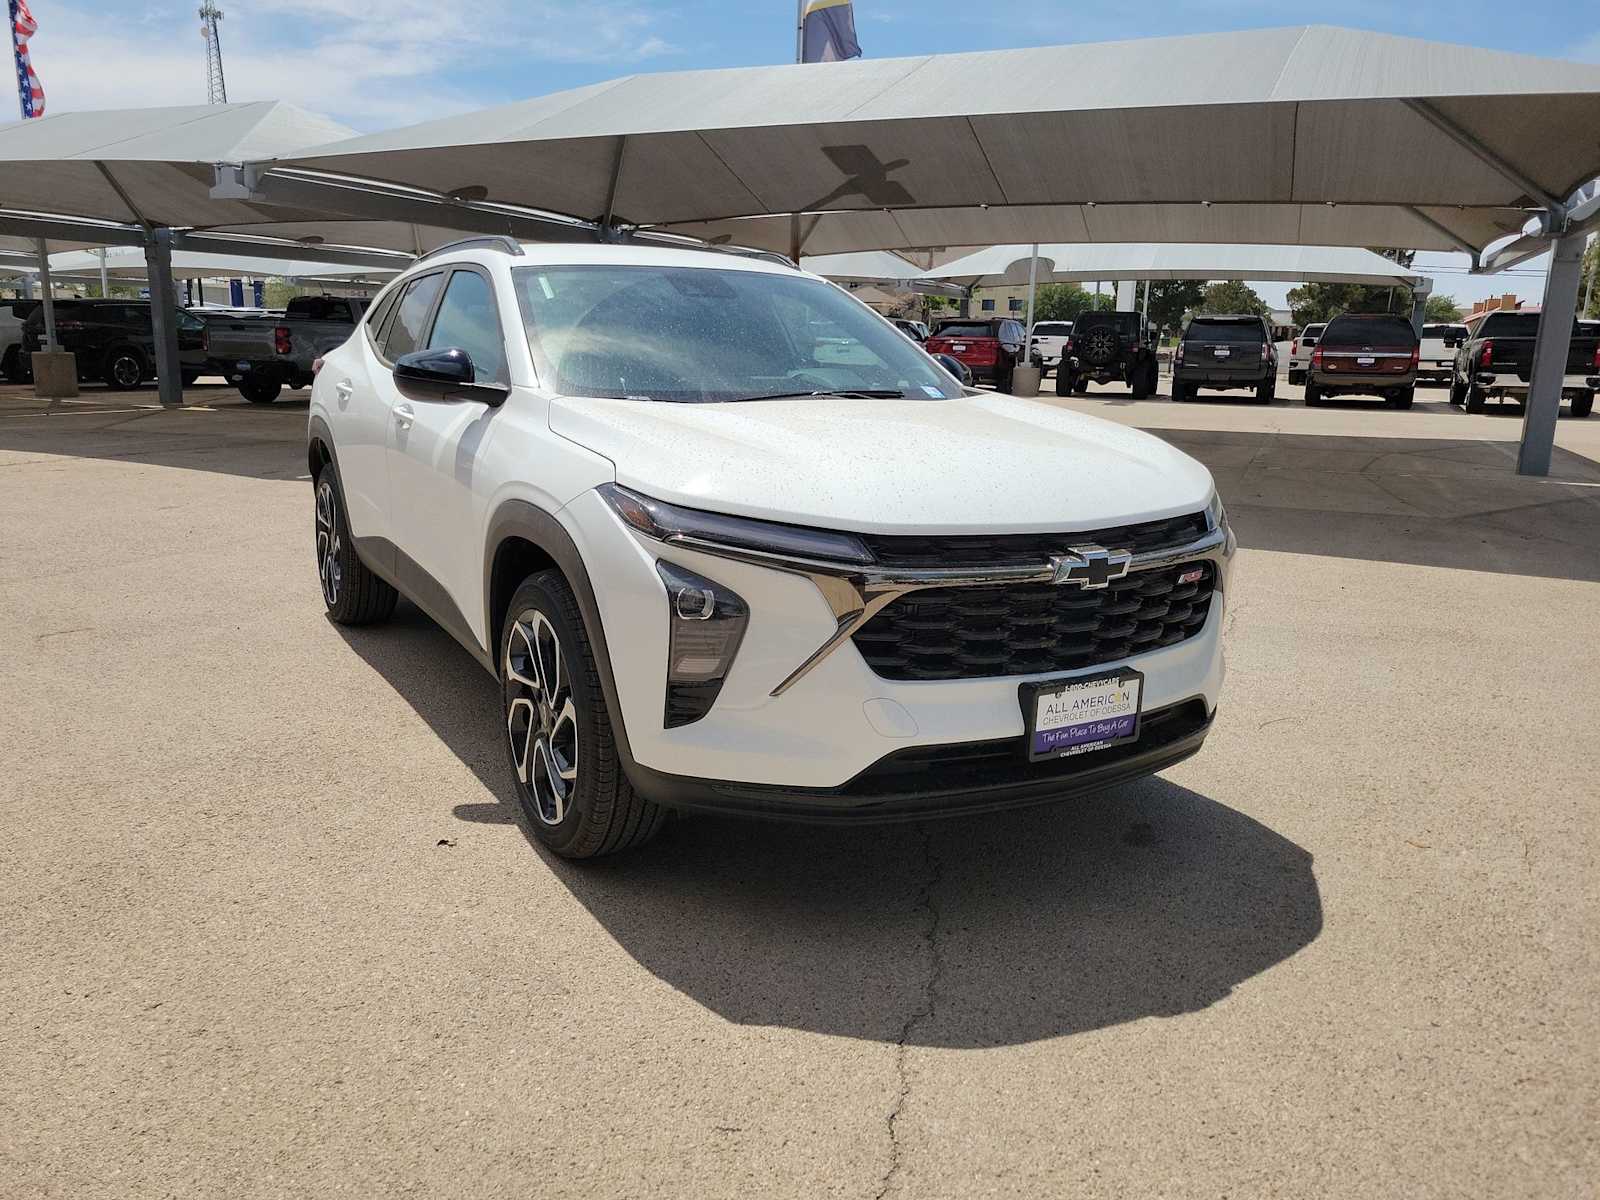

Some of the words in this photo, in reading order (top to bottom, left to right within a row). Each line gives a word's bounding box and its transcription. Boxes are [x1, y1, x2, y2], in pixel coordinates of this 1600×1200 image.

[1043, 711, 1088, 725] CHEVROLET
[1090, 708, 1101, 717] OF
[1101, 703, 1131, 715] ODESSA
[1046, 702, 1068, 715] ALL
[1042, 732, 1055, 744] The
[1069, 727, 1088, 739] Place
[1088, 724, 1098, 735] To
[1097, 722, 1111, 735] Buy
[1110, 720, 1118, 731] A
[1118, 719, 1129, 729] Car
